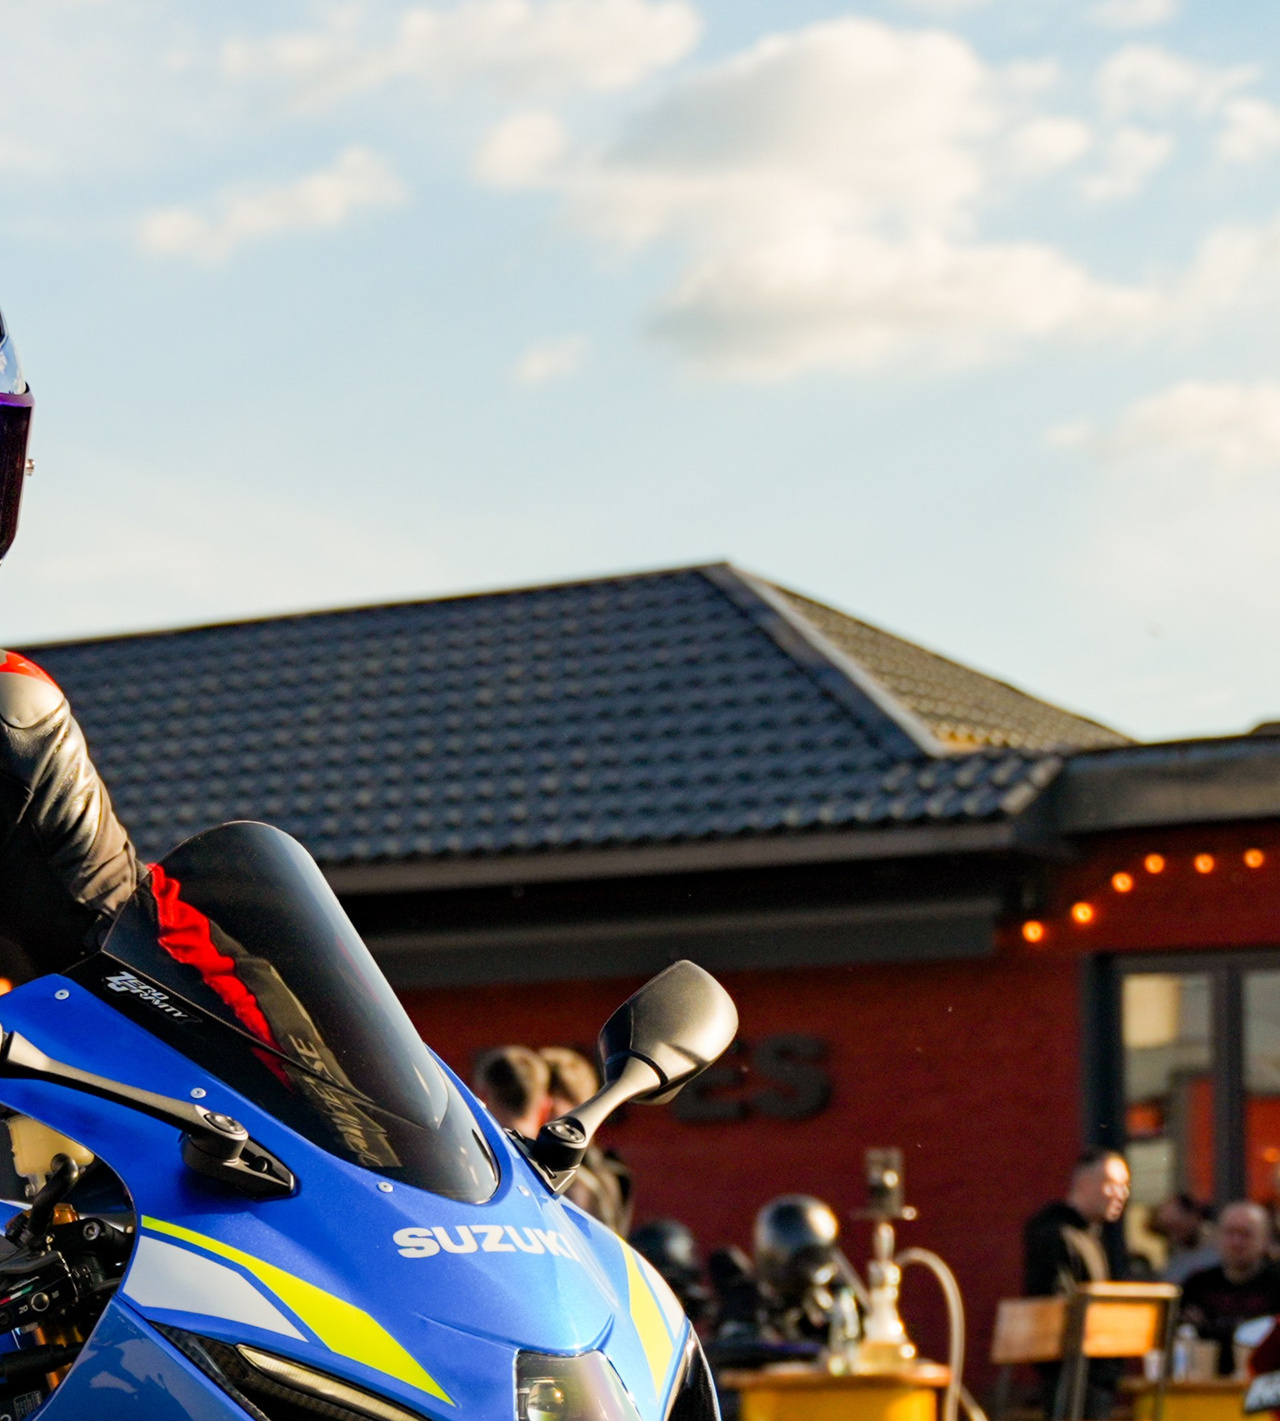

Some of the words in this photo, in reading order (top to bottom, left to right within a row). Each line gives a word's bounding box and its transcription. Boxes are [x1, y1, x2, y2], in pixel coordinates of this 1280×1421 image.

[106, 971, 170, 1000] ZERO
[108, 982, 188, 1018] GRAVITY
[392, 1224, 582, 1262] SUZUKI
